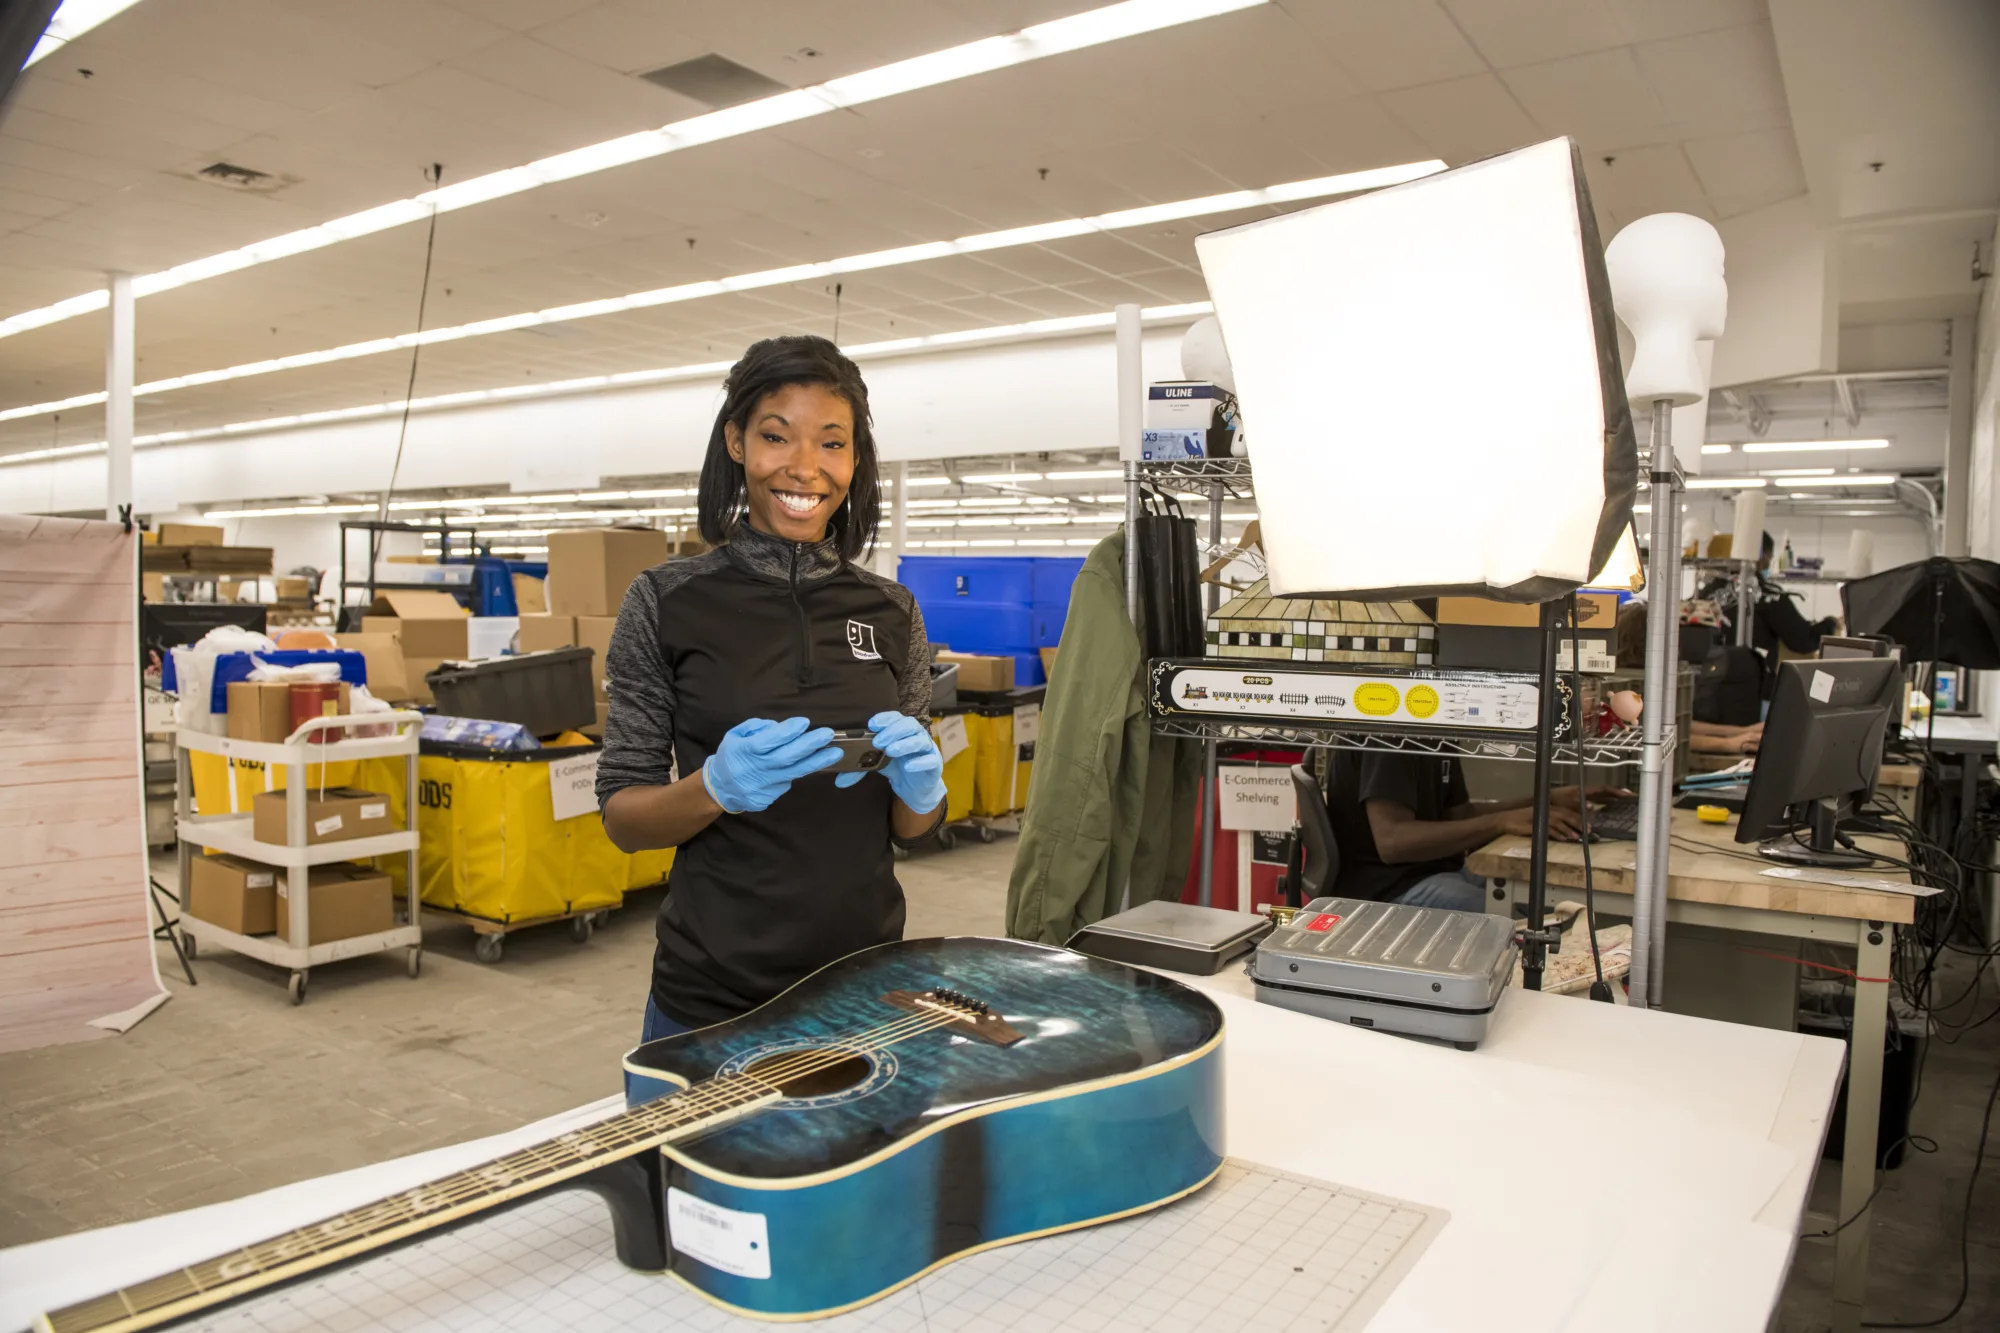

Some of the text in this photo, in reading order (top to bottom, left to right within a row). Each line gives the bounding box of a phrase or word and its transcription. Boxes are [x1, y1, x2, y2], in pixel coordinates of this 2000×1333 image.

[1166, 389, 1192, 397] ULINE
[1145, 433, 1158, 442] X3
[555, 763, 597, 777] E-Commer
[1225, 775, 1290, 786] E-Commerce
[419, 779, 452, 809] ODS
[1236, 793, 1279, 805] Shelving
